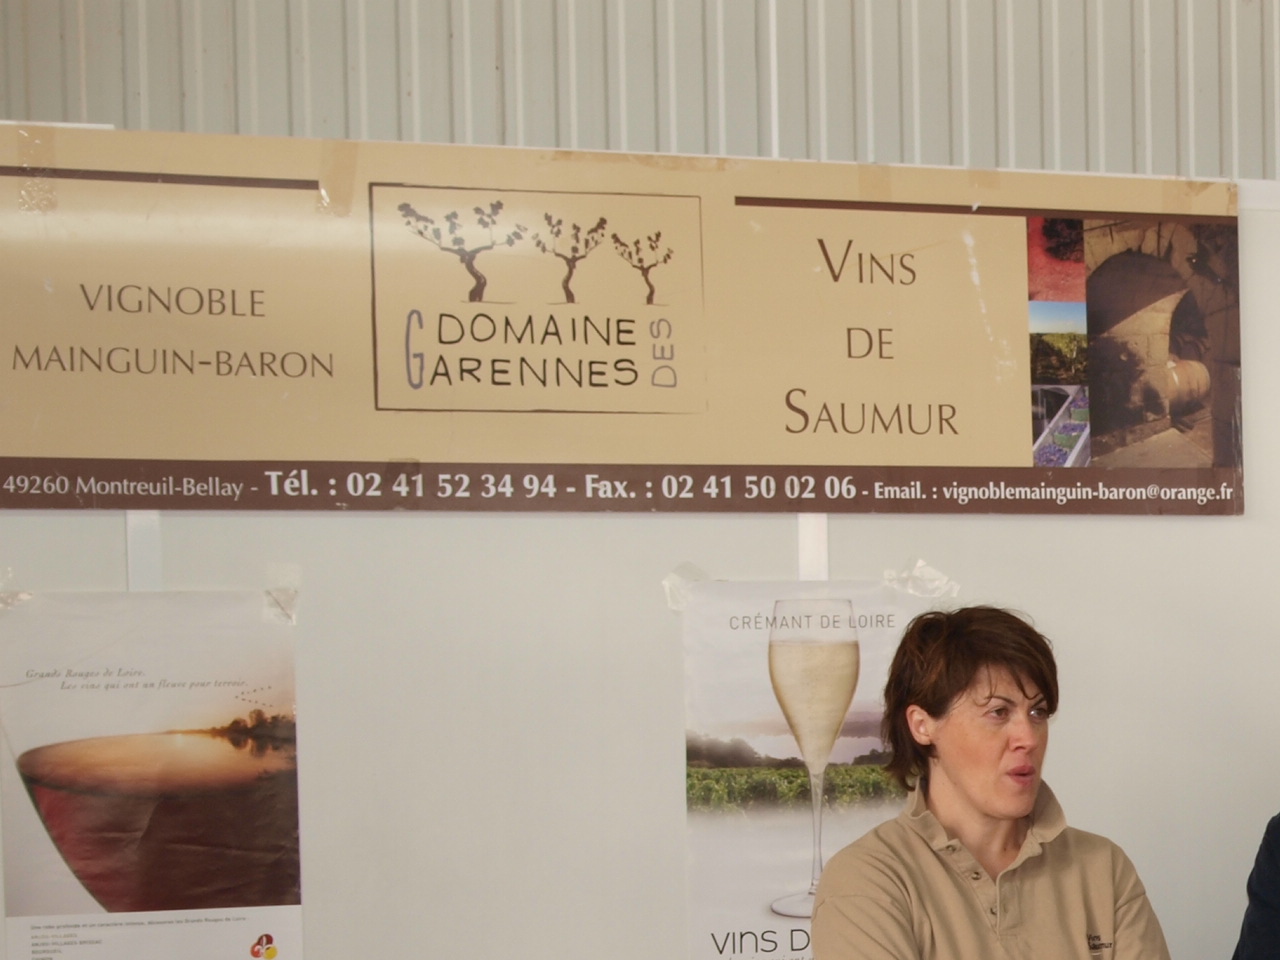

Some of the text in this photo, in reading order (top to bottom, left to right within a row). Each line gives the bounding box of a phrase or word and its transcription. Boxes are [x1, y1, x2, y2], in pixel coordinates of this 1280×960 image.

[80, 283, 266, 318] VIGNOBLE
[438, 313, 637, 346] DOMAINE
[846, 327, 895, 360] DE
[12, 344, 335, 379] MAINGUIN-BARON
[650, 317, 678, 389] DES
[2, 475, 69, 494] 49260
[76, 475, 244, 501] Montreuil-Bellay
[264, 469, 318, 497] Tél.
[346, 473, 382, 497] 02
[392, 473, 424, 497] 41
[437, 474, 471, 498] 52
[480, 474, 514, 498] 34
[522, 474, 557, 498] 94
[585, 474, 636, 499] Fax.
[662, 475, 694, 499] 02
[703, 475, 732, 499] 41
[745, 475, 776, 500] 50
[784, 475, 816, 500] 02
[824, 476, 857, 500] 06
[874, 482, 927, 500] Email.
[943, 482, 1233, 506] vignoblemainguin-baron@orange.fr
[729, 612, 896, 630] CRÉMANT DE LOIRE
